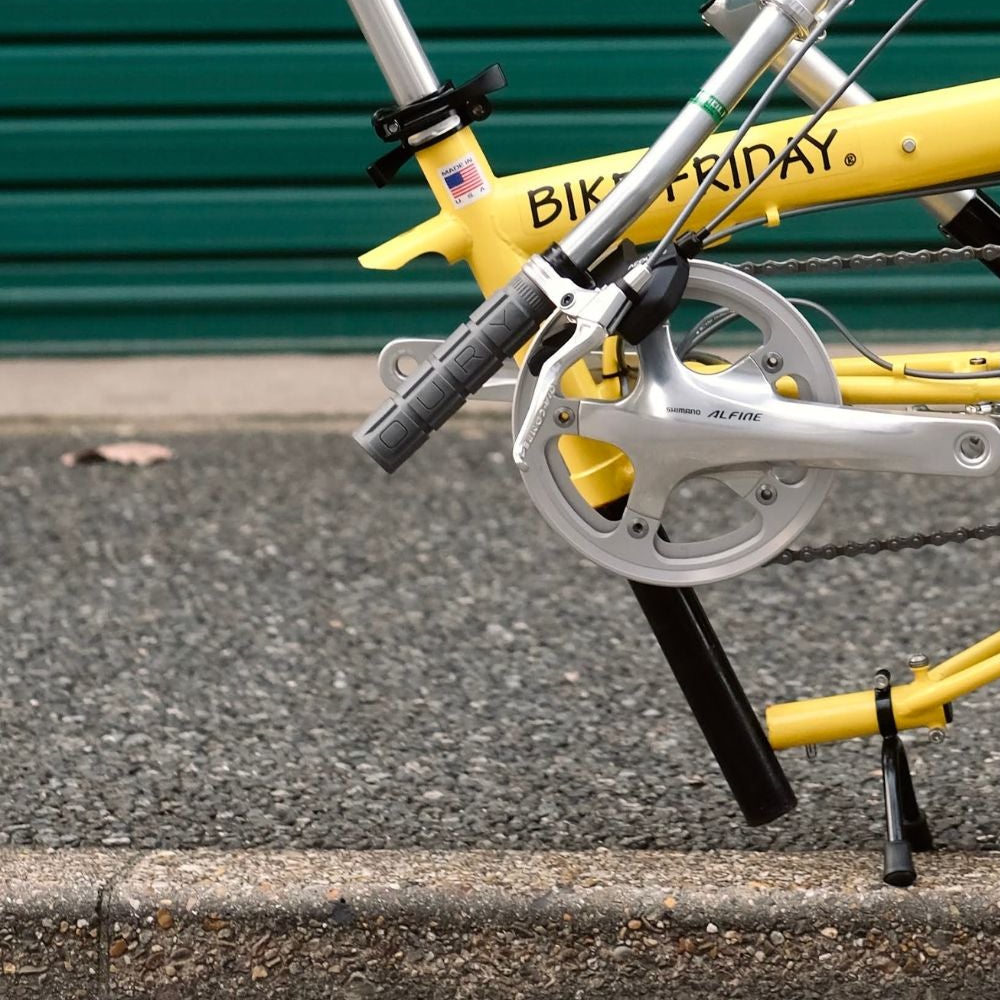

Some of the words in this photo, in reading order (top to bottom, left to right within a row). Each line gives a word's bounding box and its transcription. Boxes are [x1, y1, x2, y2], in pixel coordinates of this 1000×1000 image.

[441, 162, 463, 176] MADE
[465, 157, 473, 166] IN
[379, 309, 511, 449] OURY
[666, 406, 701, 416] SHIMANO
[707, 410, 763, 422] ALFINE
